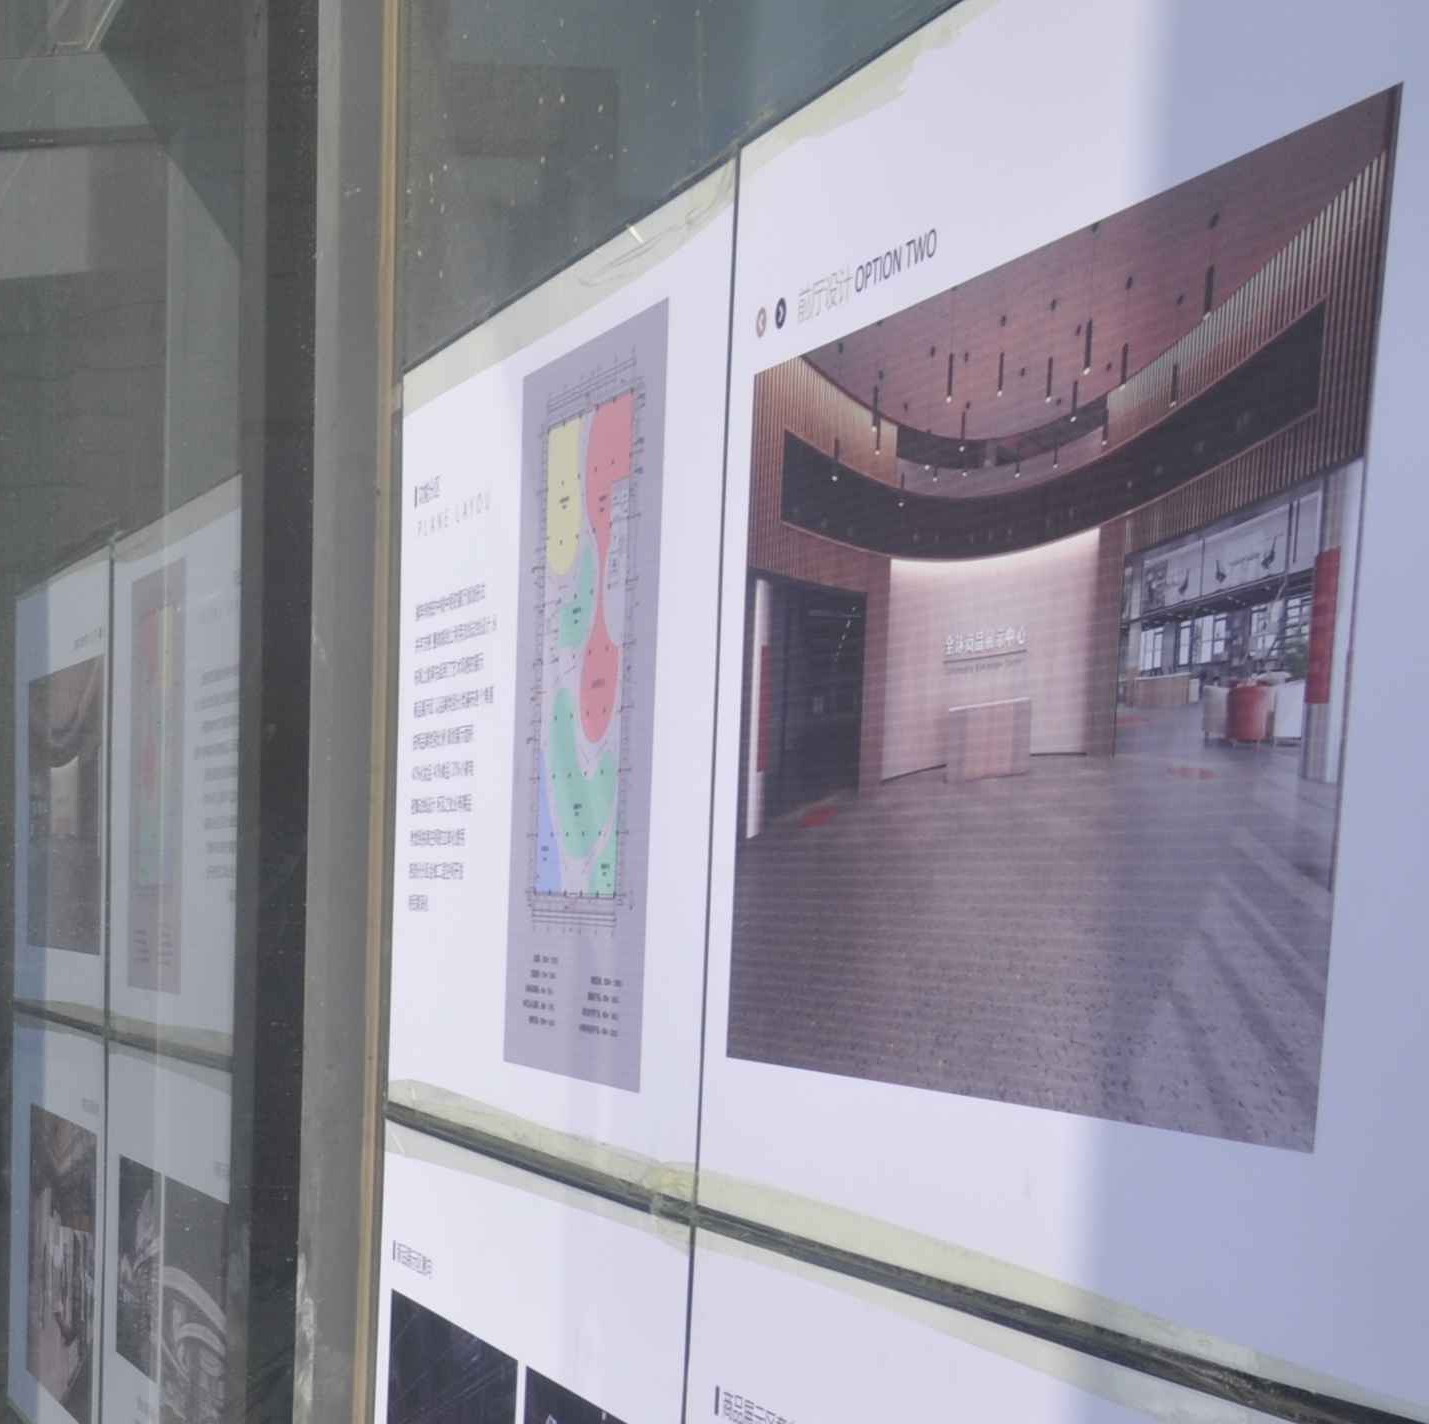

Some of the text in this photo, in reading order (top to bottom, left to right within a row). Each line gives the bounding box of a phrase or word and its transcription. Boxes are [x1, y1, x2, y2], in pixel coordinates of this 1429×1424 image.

[797, 228, 938, 324] 前厅设计 OPTION TWO
